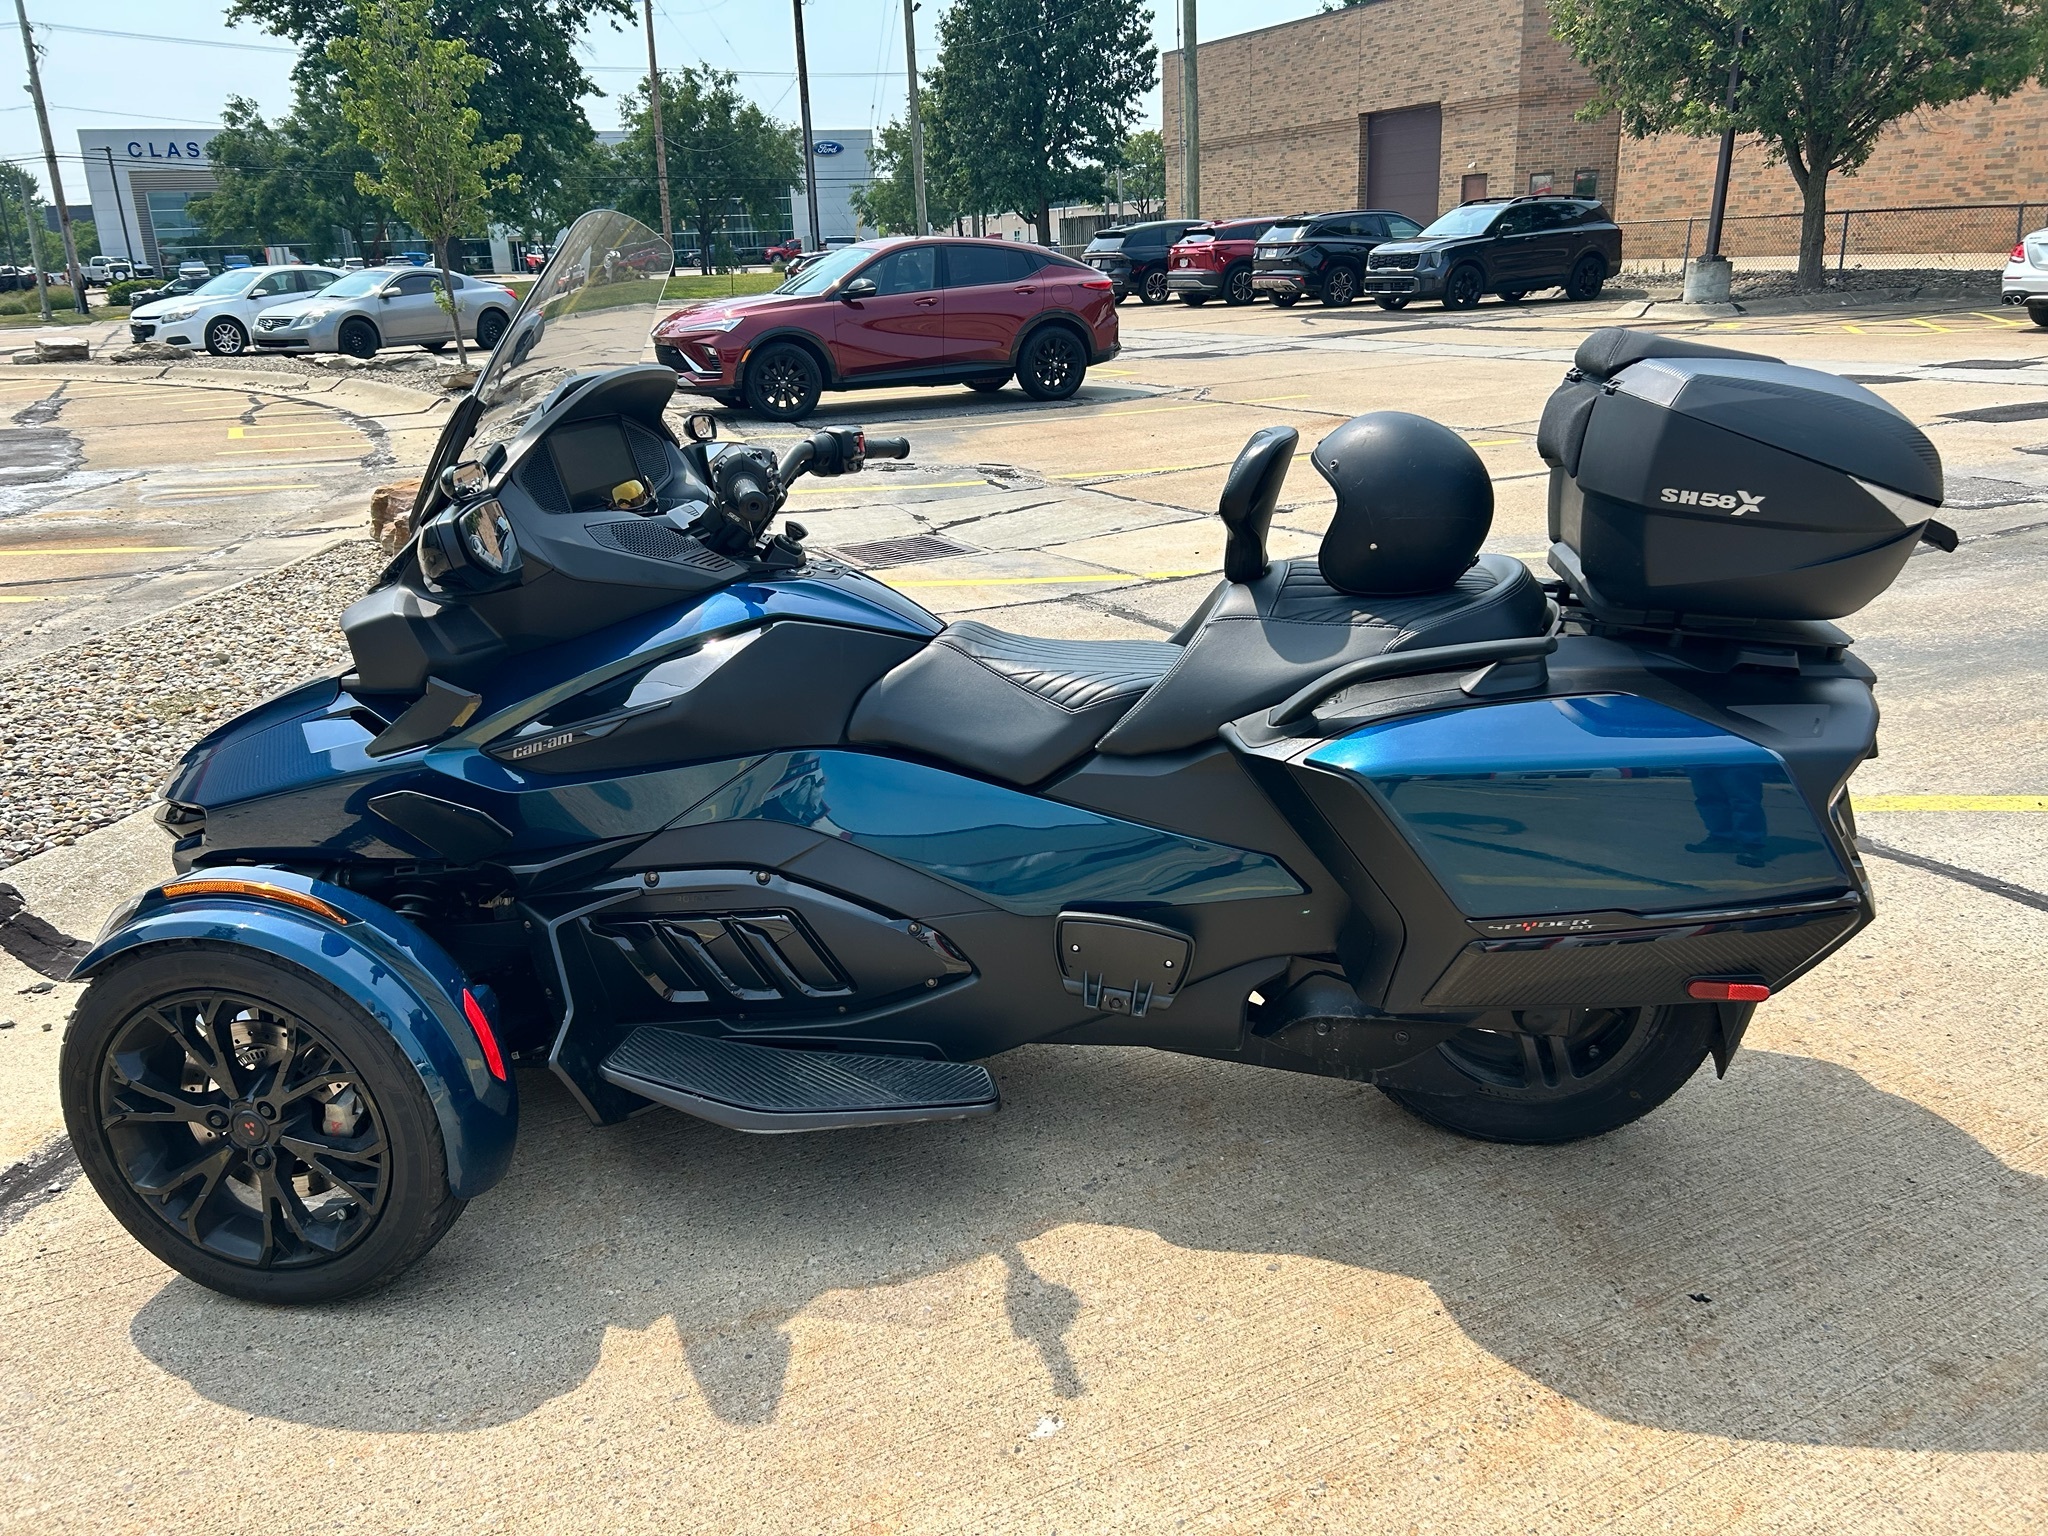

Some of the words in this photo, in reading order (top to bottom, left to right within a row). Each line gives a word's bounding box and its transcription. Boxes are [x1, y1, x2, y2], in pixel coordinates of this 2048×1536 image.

[127, 141, 200, 158] CLAS
[817, 143, 838, 153] Ford
[1660, 488, 1766, 516] SH58X
[512, 732, 573, 759] can-am
